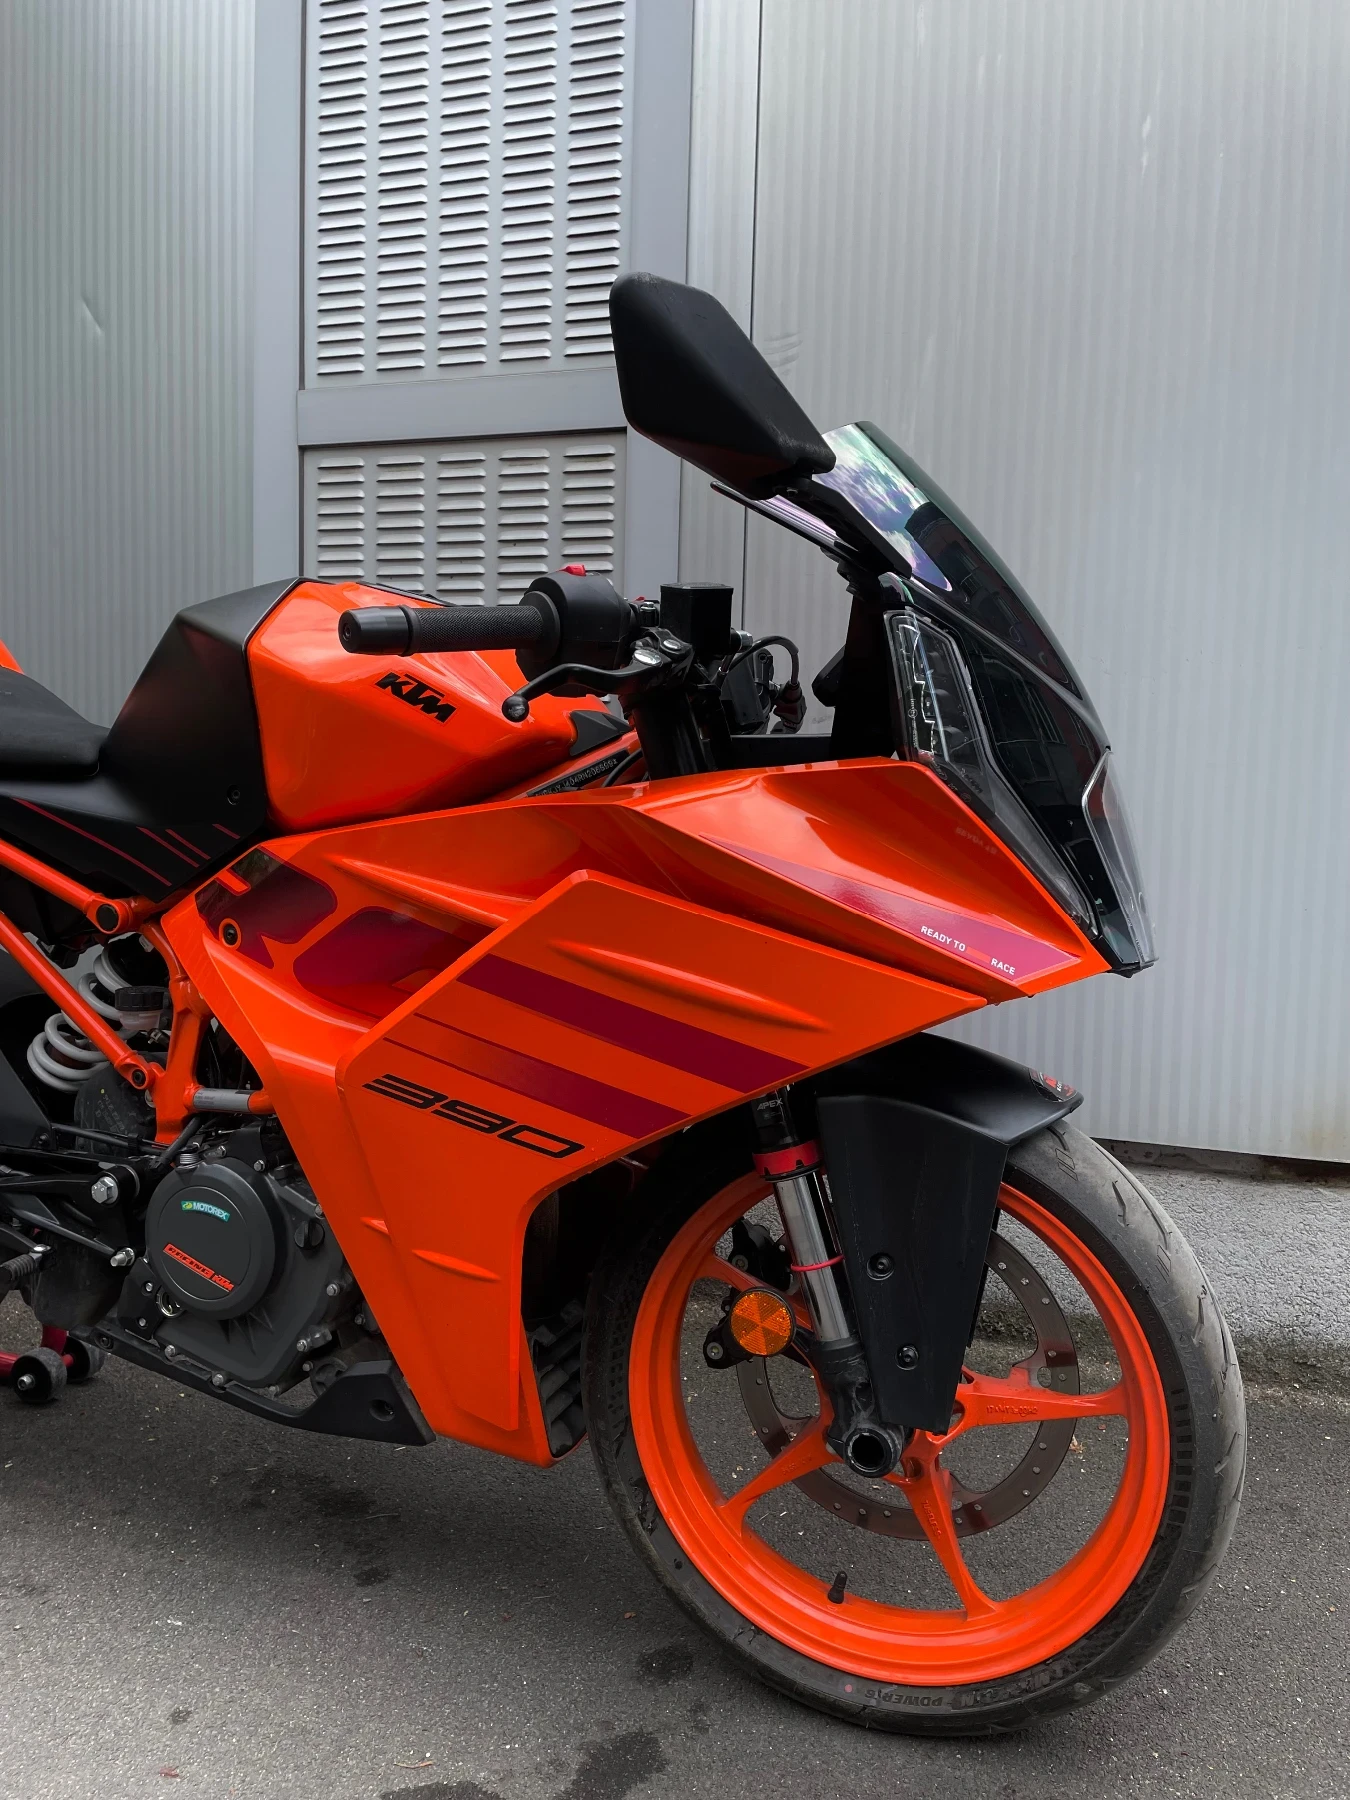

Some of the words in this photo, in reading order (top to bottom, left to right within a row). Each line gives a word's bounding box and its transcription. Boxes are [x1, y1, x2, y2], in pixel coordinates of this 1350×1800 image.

[374, 672, 457, 723] KTM
[921, 926, 952, 945] READY
[954, 940, 966, 952] TO
[991, 958, 1016, 976] RACE
[362, 1074, 586, 1159] 390
[757, 1098, 783, 1110] APEX
[193, 1202, 229, 1220] MOTOREX
[166, 1245, 211, 1277] RACING
[212, 1275, 234, 1291] KTM
[882, 1690, 944, 1707] POWER
